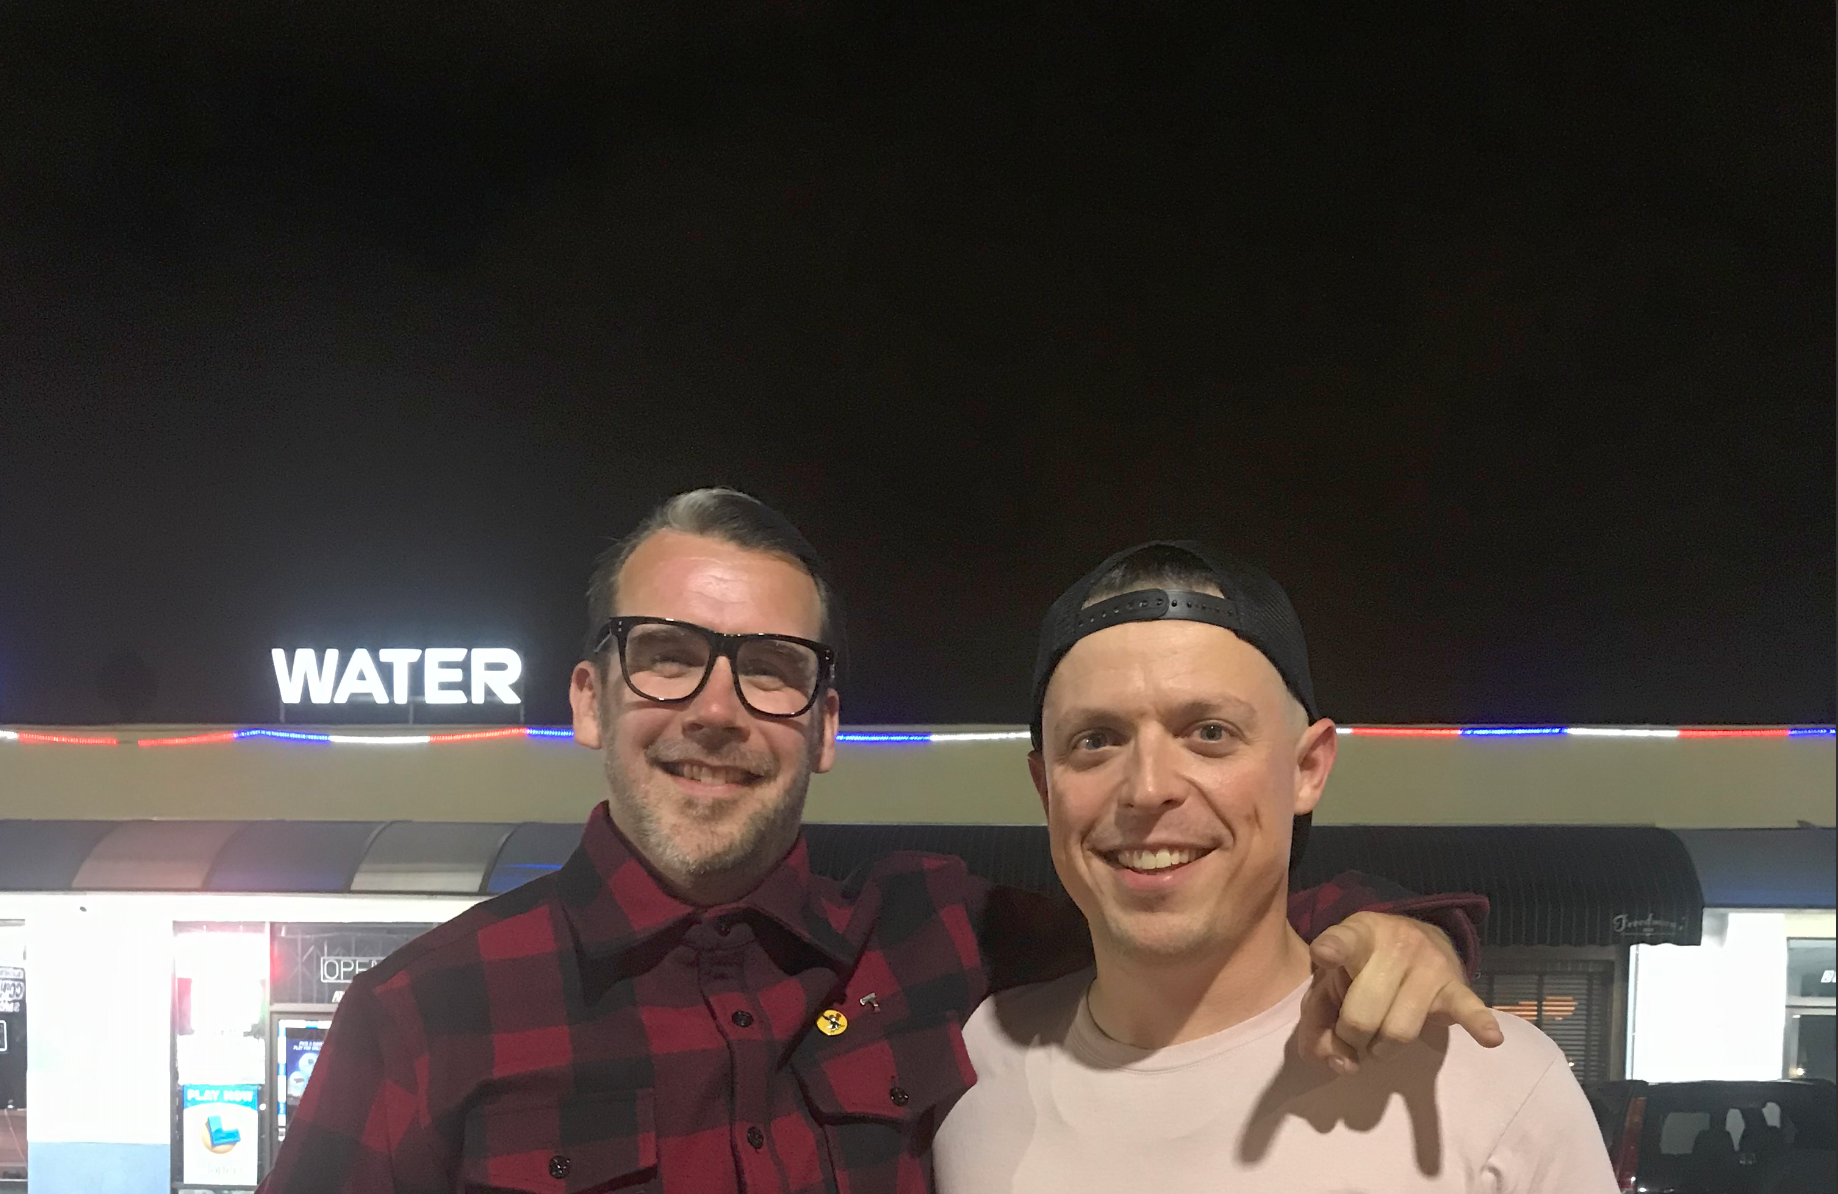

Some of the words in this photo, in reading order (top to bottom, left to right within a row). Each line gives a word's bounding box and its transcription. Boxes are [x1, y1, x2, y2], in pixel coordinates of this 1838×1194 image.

[271, 648, 522, 704] WATER
[187, 1089, 220, 1101] PLAY
[223, 1090, 254, 1102] NOW
